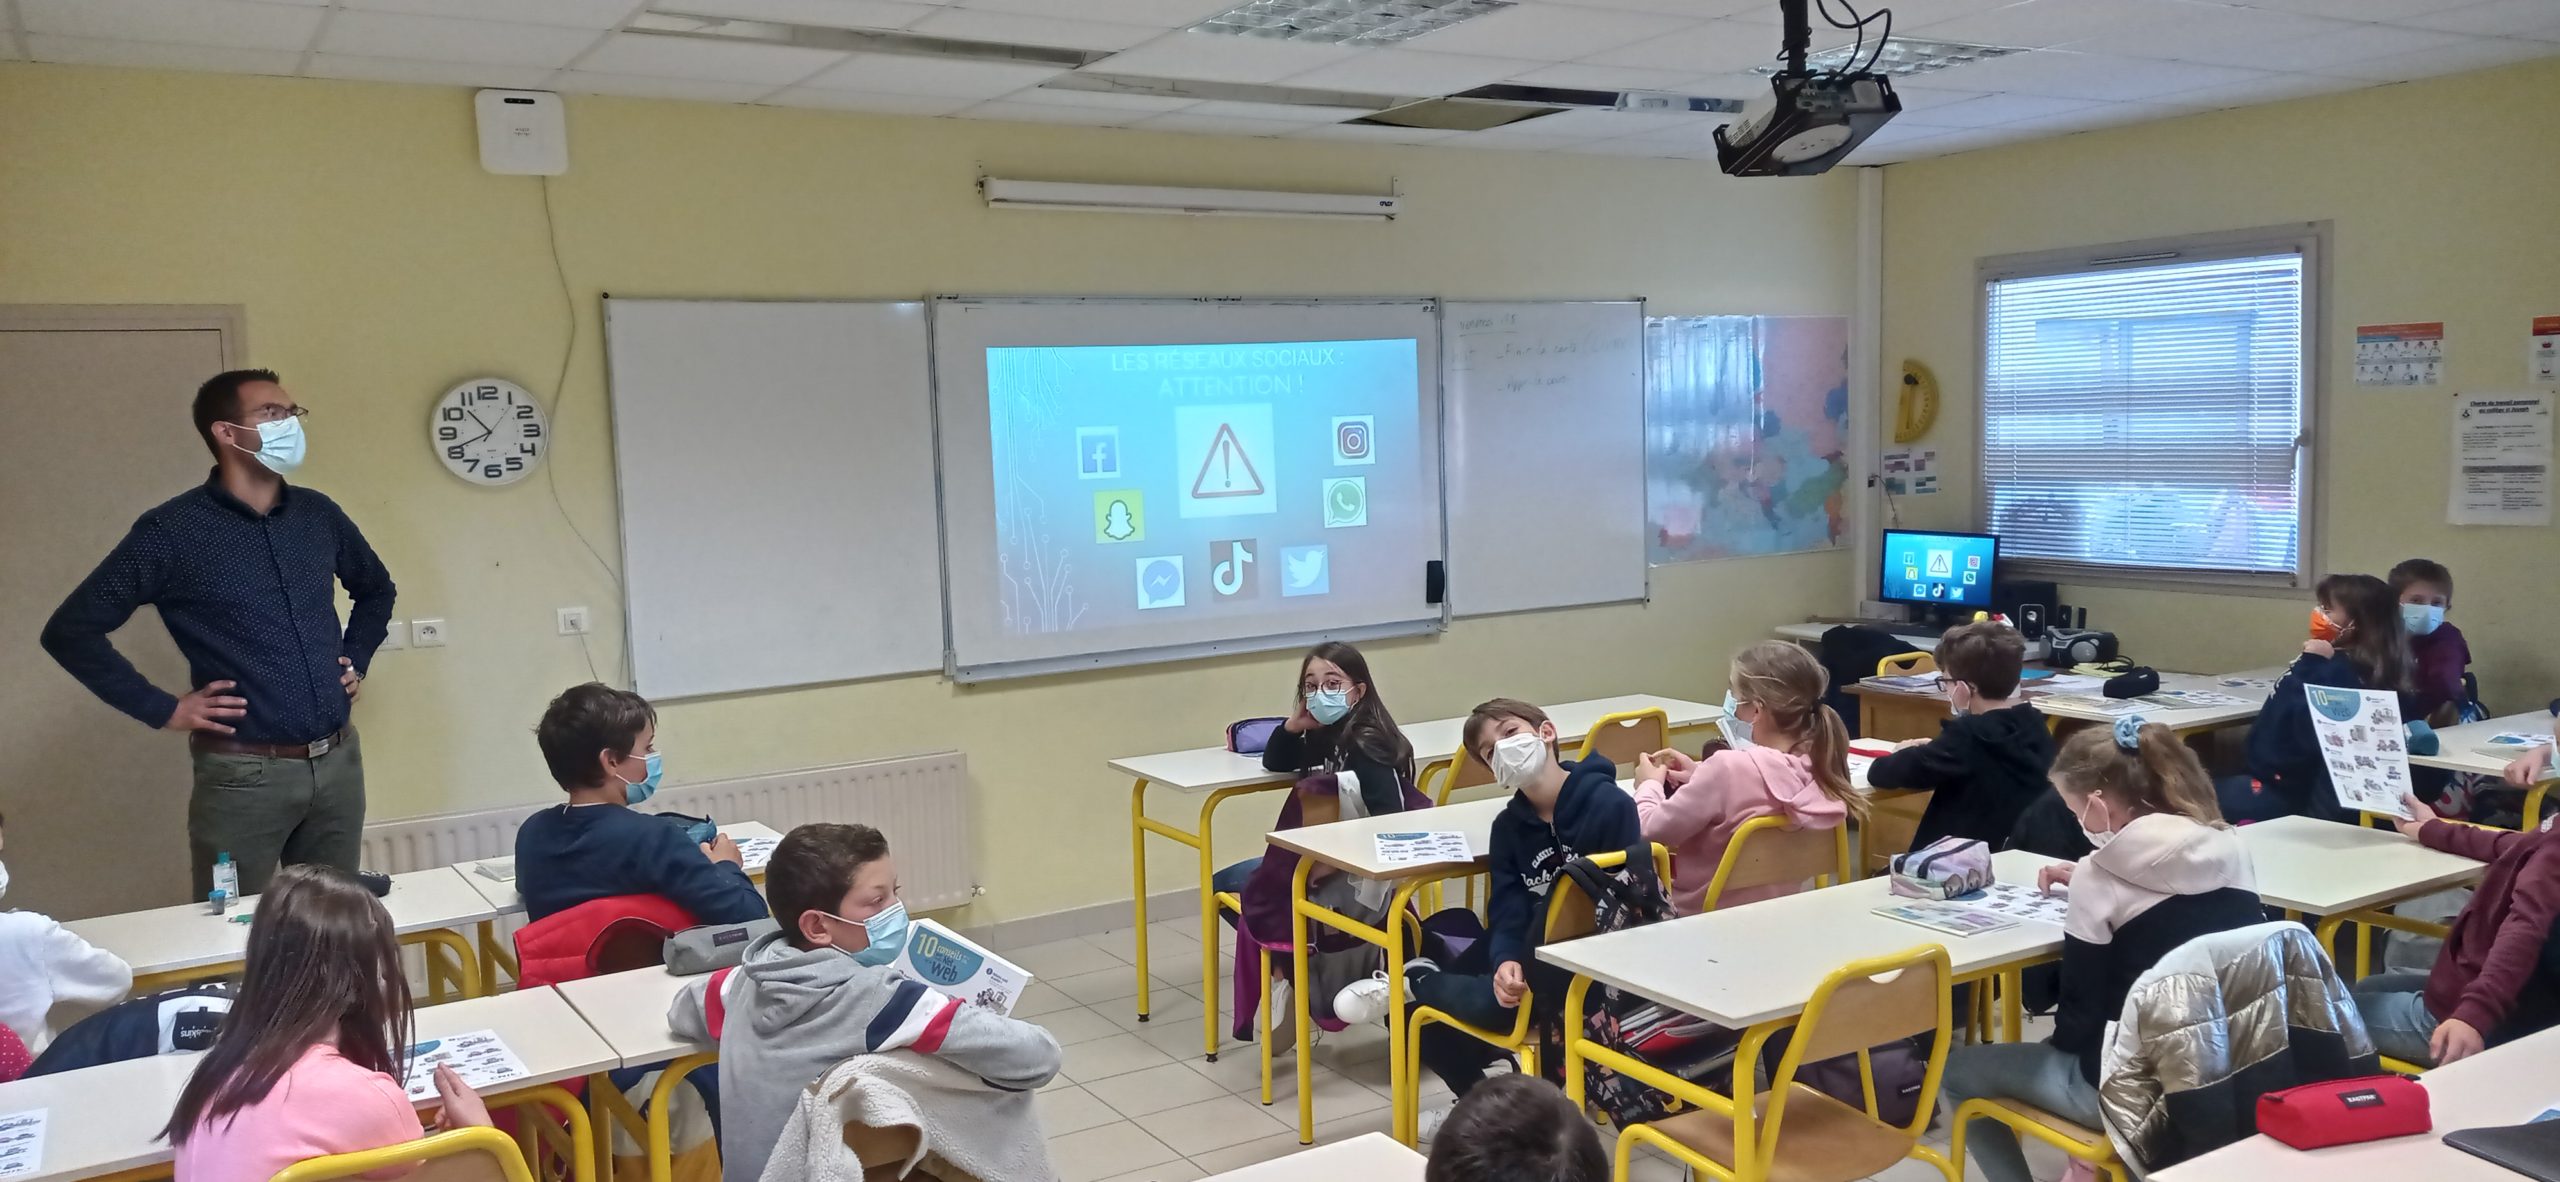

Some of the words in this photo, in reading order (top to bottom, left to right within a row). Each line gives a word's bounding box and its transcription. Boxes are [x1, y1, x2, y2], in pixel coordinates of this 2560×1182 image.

[1111, 352, 1149, 372] LES
[1154, 348, 1249, 371] RÉSEAUX
[1251, 347, 1335, 368] SOCIAUX
[477, 385, 499, 400] 12
[1157, 373, 1292, 398] ATTENTION
[461, 392, 473, 406] 11
[508, 391, 513, 405] 1
[442, 407, 464, 421] 10
[516, 405, 534, 419] 2
[439, 426, 457, 440] 9
[523, 424, 541, 438] 3
[447, 446, 465, 459] 8
[520, 443, 536, 456] 4
[462, 459, 480, 473] 7
[484, 464, 502, 478] 6
[505, 457, 523, 471] 5
[2311, 690, 2329, 706] 10
[917, 933, 938, 957] 10
